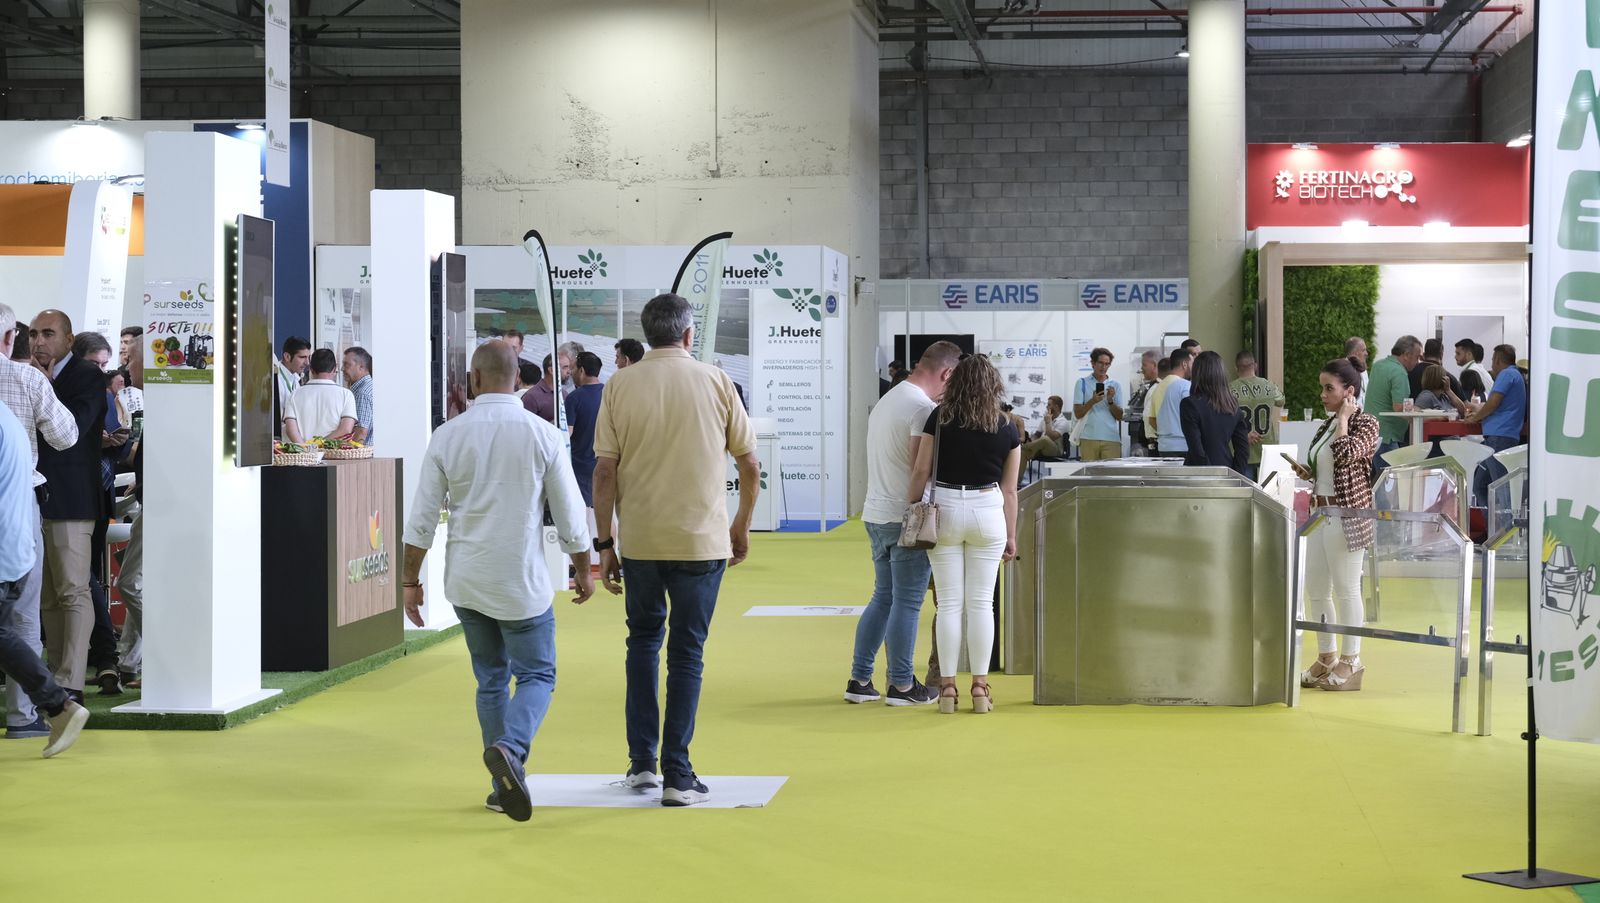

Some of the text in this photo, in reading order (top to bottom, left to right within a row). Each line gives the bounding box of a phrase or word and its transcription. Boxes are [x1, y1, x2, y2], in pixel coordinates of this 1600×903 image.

[1299, 170, 1414, 185] FERTINAGRO
[1299, 185, 1374, 199] BIOTECH
[975, 284, 1039, 304] EARIS
[1113, 283, 1178, 304] EARIS
[153, 300, 204, 309] surseeds
[768, 325, 822, 338] J.Huete
[1018, 348, 1048, 357] EARIS
